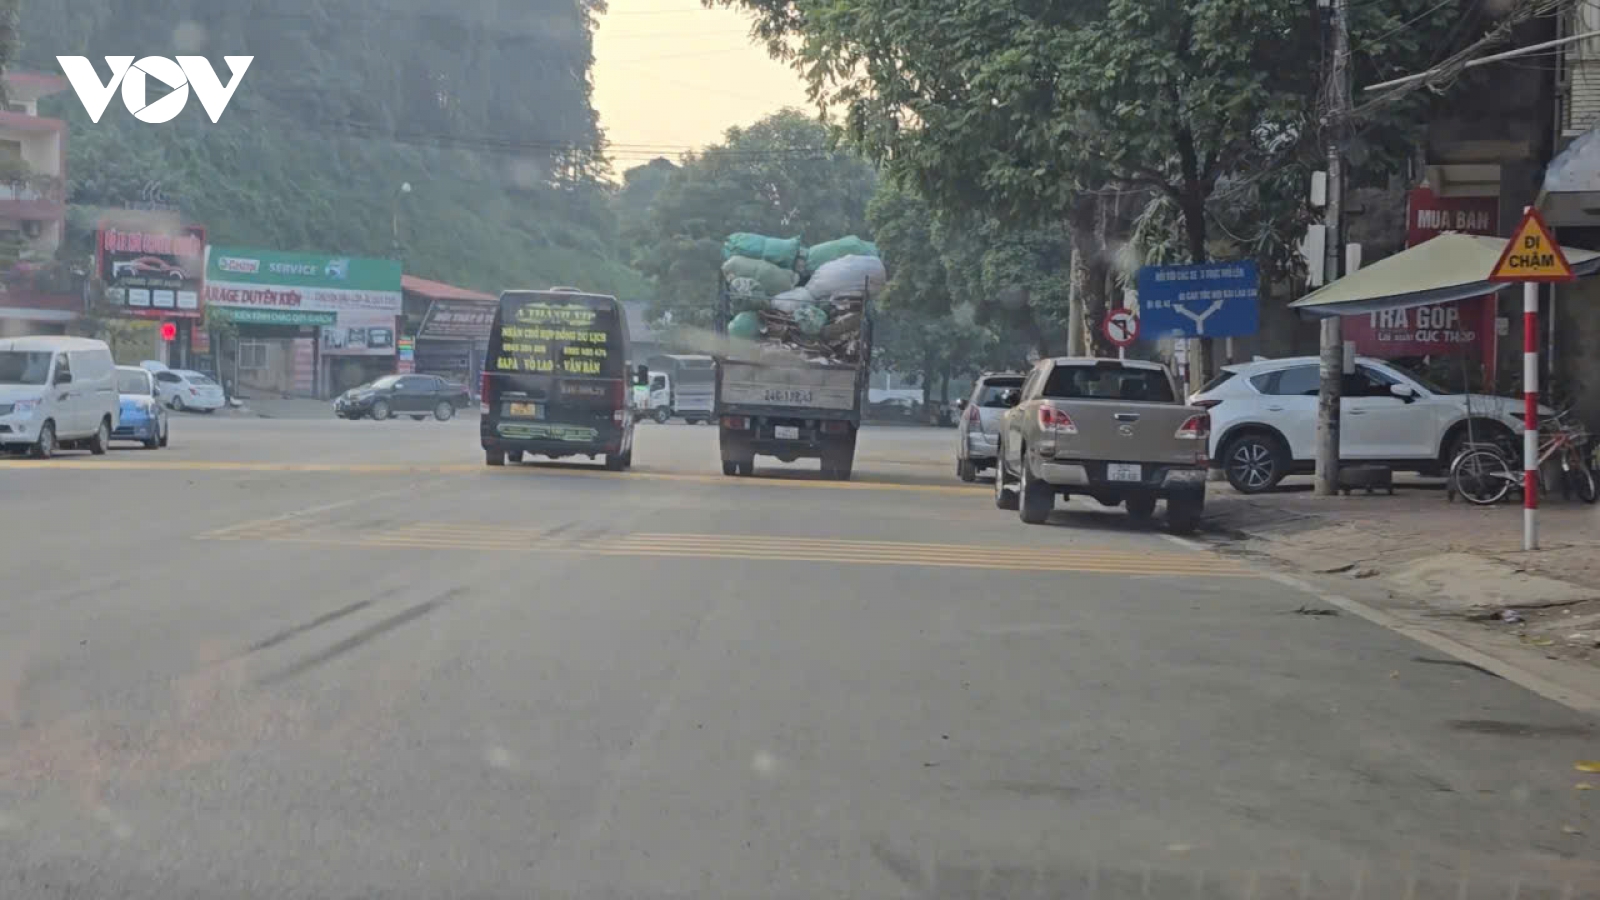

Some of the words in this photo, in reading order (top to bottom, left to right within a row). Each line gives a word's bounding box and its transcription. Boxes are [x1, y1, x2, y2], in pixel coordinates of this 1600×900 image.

[1417, 209, 1450, 229] MUA
[1524, 235, 1541, 250] ĐI
[268, 262, 319, 276] SERVICE
[1508, 252, 1555, 271] CHẬM
